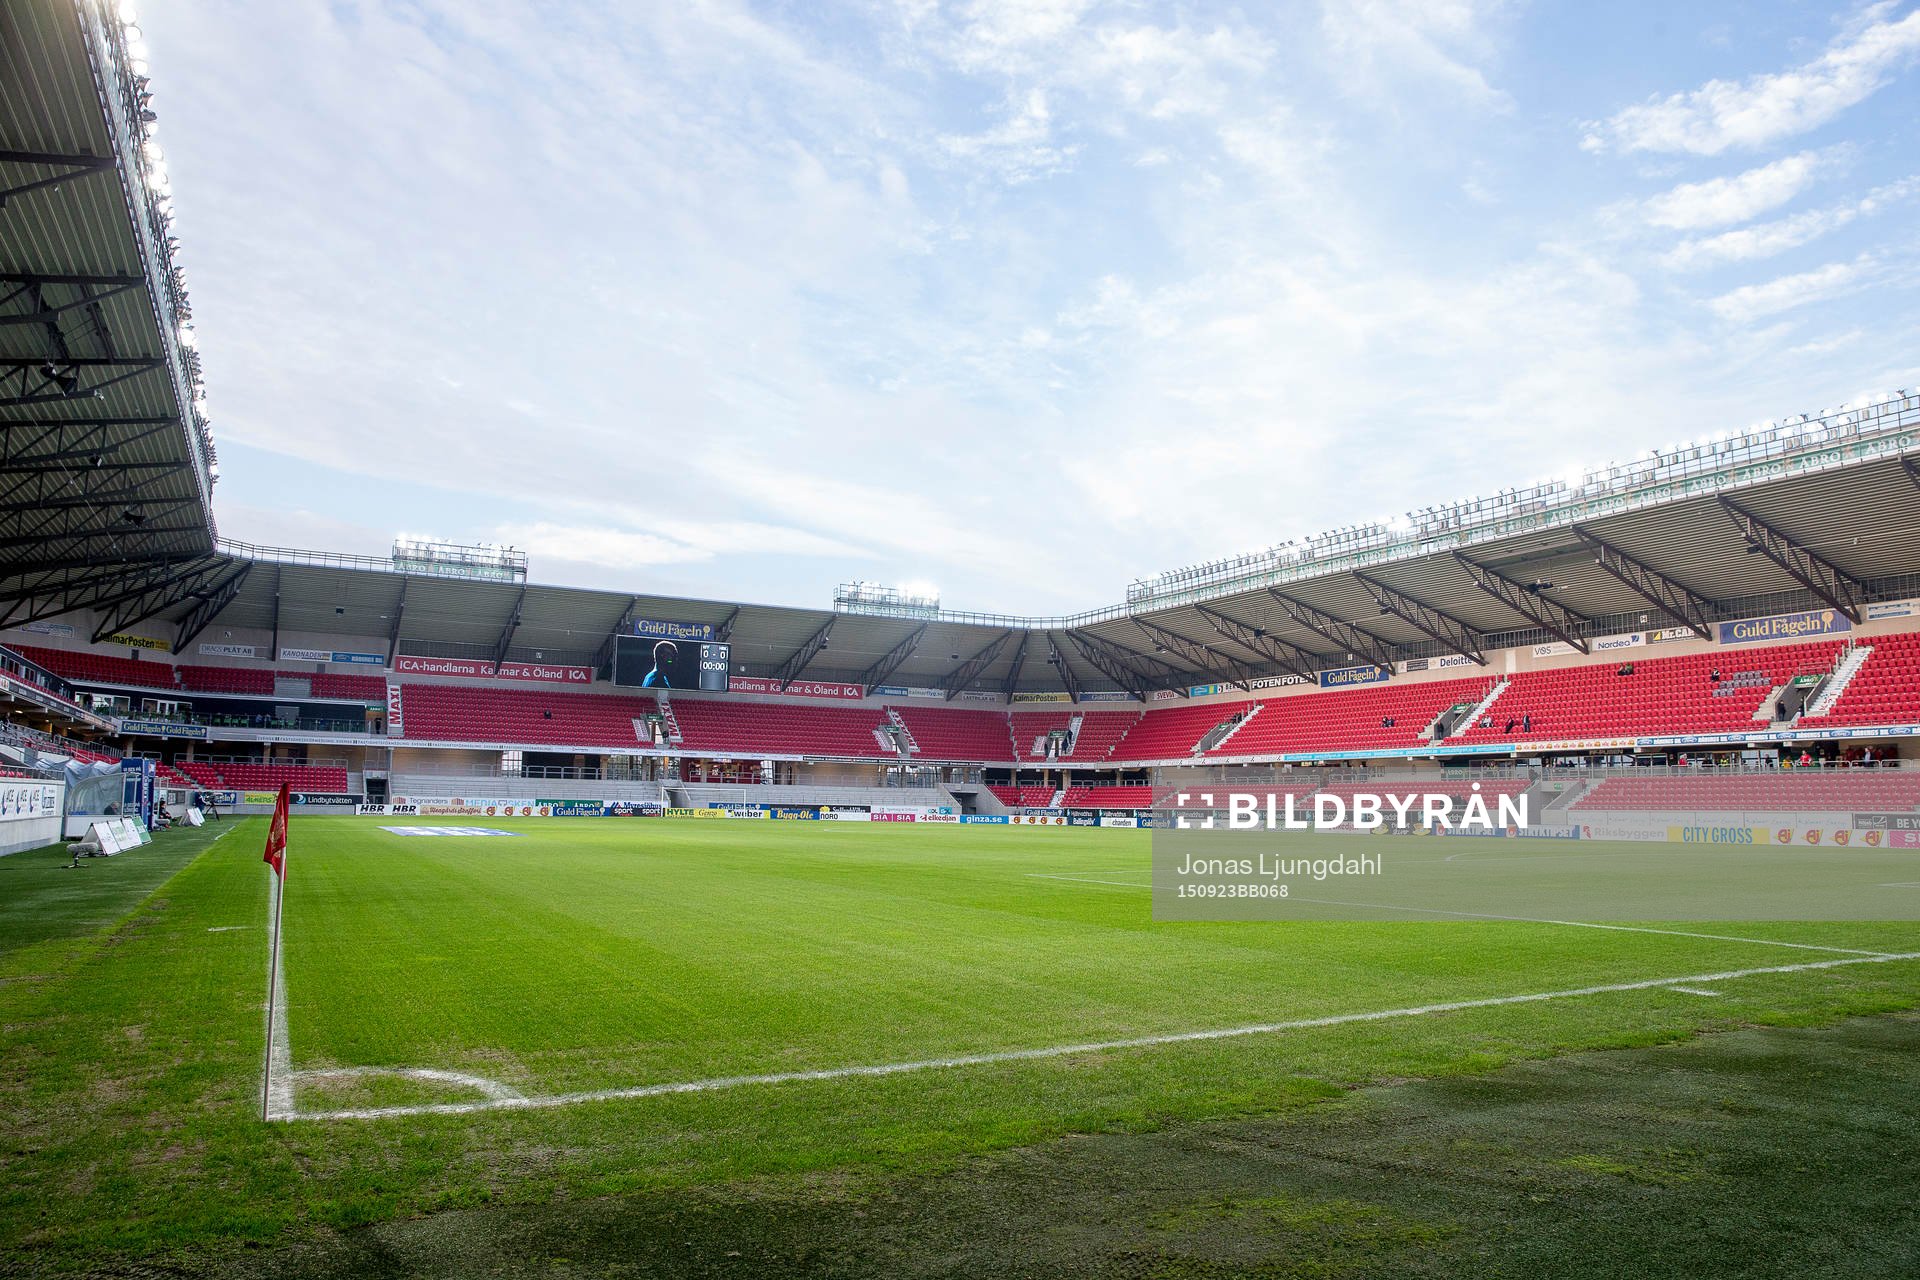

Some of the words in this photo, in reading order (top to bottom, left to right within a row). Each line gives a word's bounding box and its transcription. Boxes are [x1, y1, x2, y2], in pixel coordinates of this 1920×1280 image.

[638, 620, 666, 634] Guld
[668, 623, 702, 638] Fågeln
[1733, 621, 1769, 639] Guld
[1772, 616, 1821, 636] Fågeln
[1598, 638, 1631, 649] Nordea
[703, 650, 709, 658] 0
[720, 651, 726, 659] 0
[703, 661, 725, 670] 00:00
[1440, 656, 1472, 668] Deloitte
[399, 660, 475, 674] ICA-handlarna
[480, 665, 518, 677] Kamar
[522, 668, 530, 677] &
[533, 666, 563, 679] Öland
[569, 670, 587, 680] ICA
[1328, 670, 1347, 684] Guld
[729, 681, 765, 691] andlarna
[769, 683, 802, 694] Kamar
[805, 685, 812, 693] &
[813, 684, 839, 695] Öland
[844, 687, 859, 696] ICA
[1251, 678, 1281, 689] FOTEN
[388, 687, 401, 725] MAXI
[308, 795, 353, 805] Lindbytvätten
[360, 804, 385, 812] HBR
[392, 805, 417, 813] HBR
[556, 807, 574, 816] Guld
[667, 808, 694, 816] HYLTE
[733, 809, 762, 818] weber
[777, 810, 814, 820] Bygg-Ole
[966, 815, 1003, 825] ginza.se
[1897, 818, 1910, 829] BE
[1594, 827, 1665, 840] Riksbyggen
[1683, 826, 1708, 843] CITY
[1711, 827, 1753, 844] GROSS
